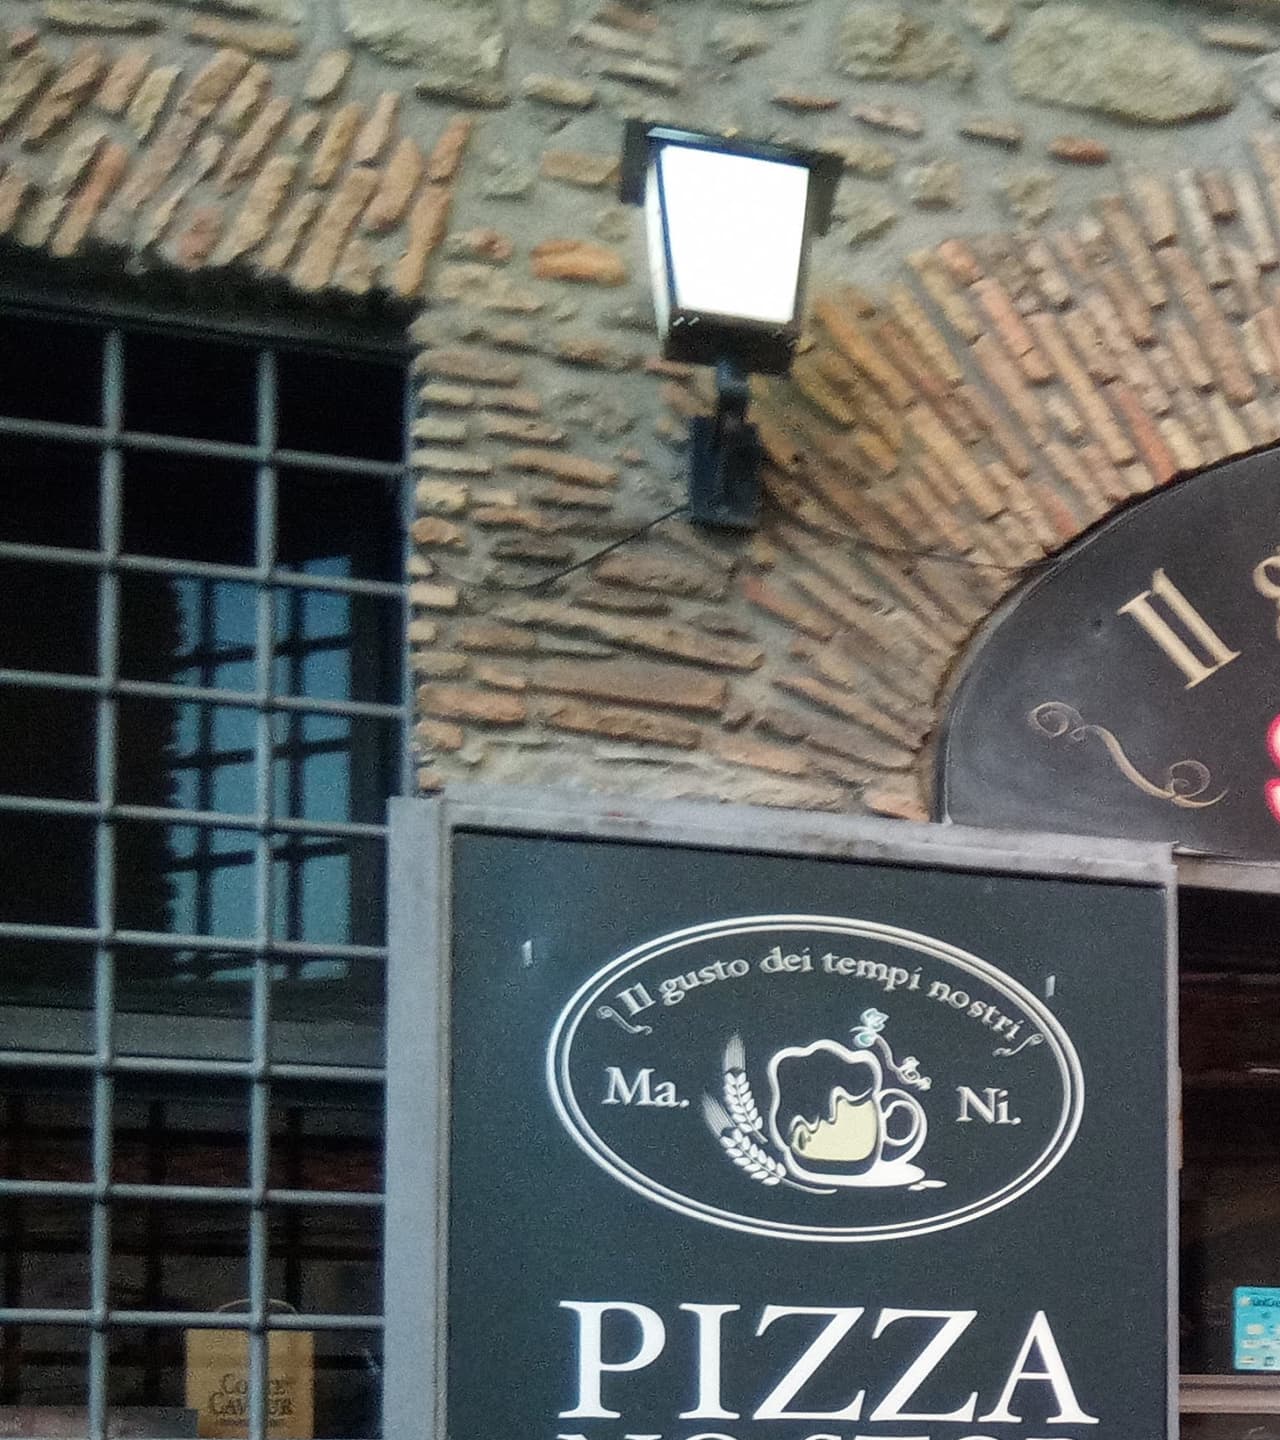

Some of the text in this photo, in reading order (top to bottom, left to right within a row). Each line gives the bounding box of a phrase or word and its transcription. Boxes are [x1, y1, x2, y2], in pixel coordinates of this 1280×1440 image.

[1119, 568, 1240, 688] Il
[615, 946, 1023, 1041] Il gusto dei tempi nostri
[601, 1066, 1021, 1125] Ma. Ni.
[558, 1300, 1100, 1424] PIZZA
